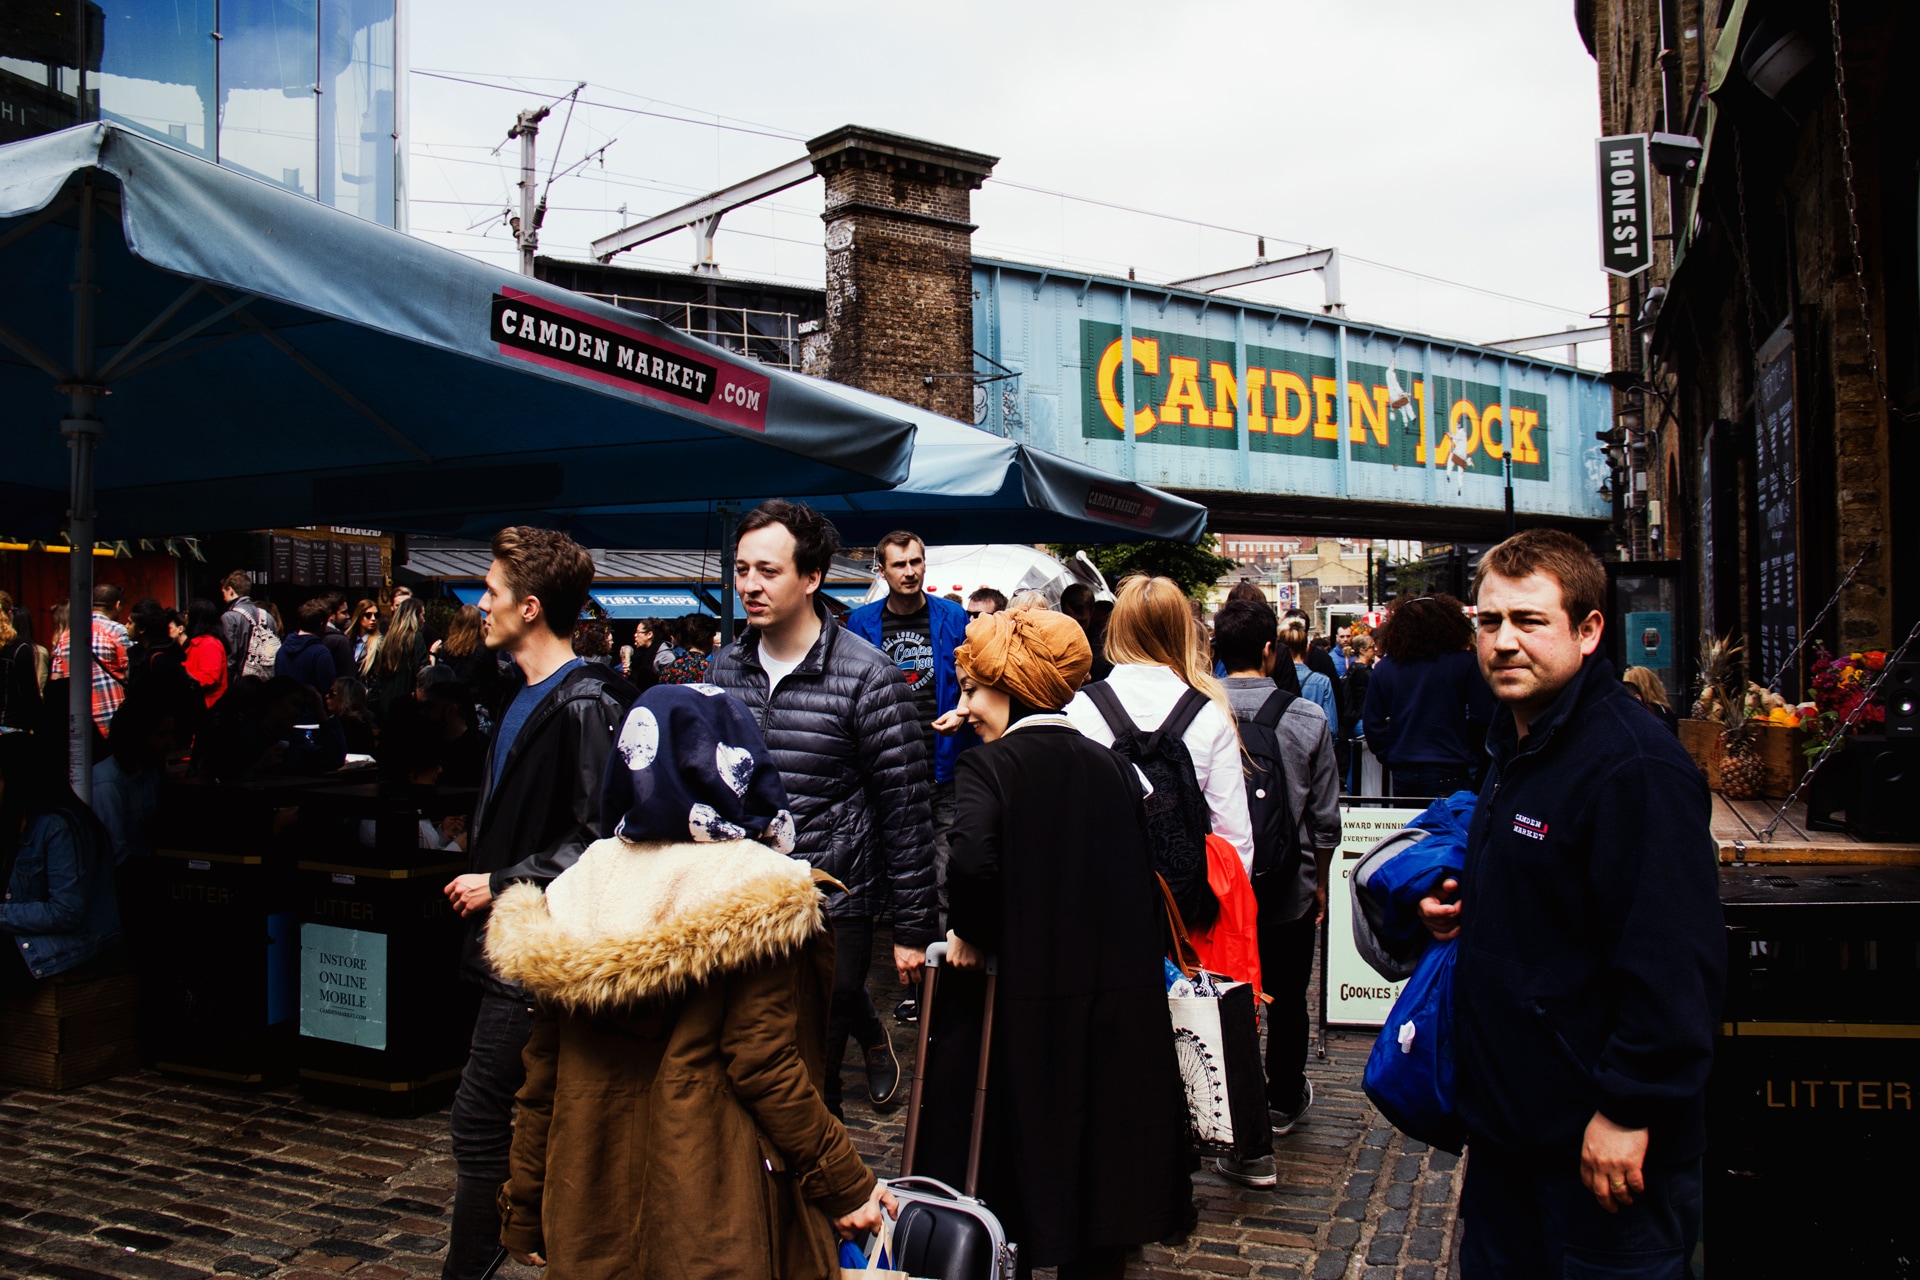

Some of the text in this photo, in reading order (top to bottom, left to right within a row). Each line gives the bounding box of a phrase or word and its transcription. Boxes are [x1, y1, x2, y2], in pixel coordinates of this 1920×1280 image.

[1610, 148, 1638, 257] HONEST
[500, 308, 761, 411] CAMDEN MARKET .COM
[1096, 335, 1389, 446] CAMDEN
[1413, 380, 1540, 466] LOCK
[1088, 491, 1116, 510] CAMDEN
[1114, 498, 1141, 515] MARKET
[597, 596, 639, 605] FISH
[648, 596, 698, 605] CHIPS
[893, 643, 933, 664] Coope
[915, 656, 934, 671] 190
[1343, 821, 1371, 830] AWARD
[1514, 813, 1543, 829] CAMDEN
[1512, 824, 1546, 841] MARKET
[171, 880, 229, 904] LITTER
[312, 896, 375, 920] LITTER
[320, 952, 367, 970] INSTORE
[319, 971, 367, 990] ONLINE
[319, 989, 367, 1008] MOBILE
[319, 1007, 367, 1020] CAMDENMARKET.COM
[1766, 1079, 1913, 1111] LITTER
